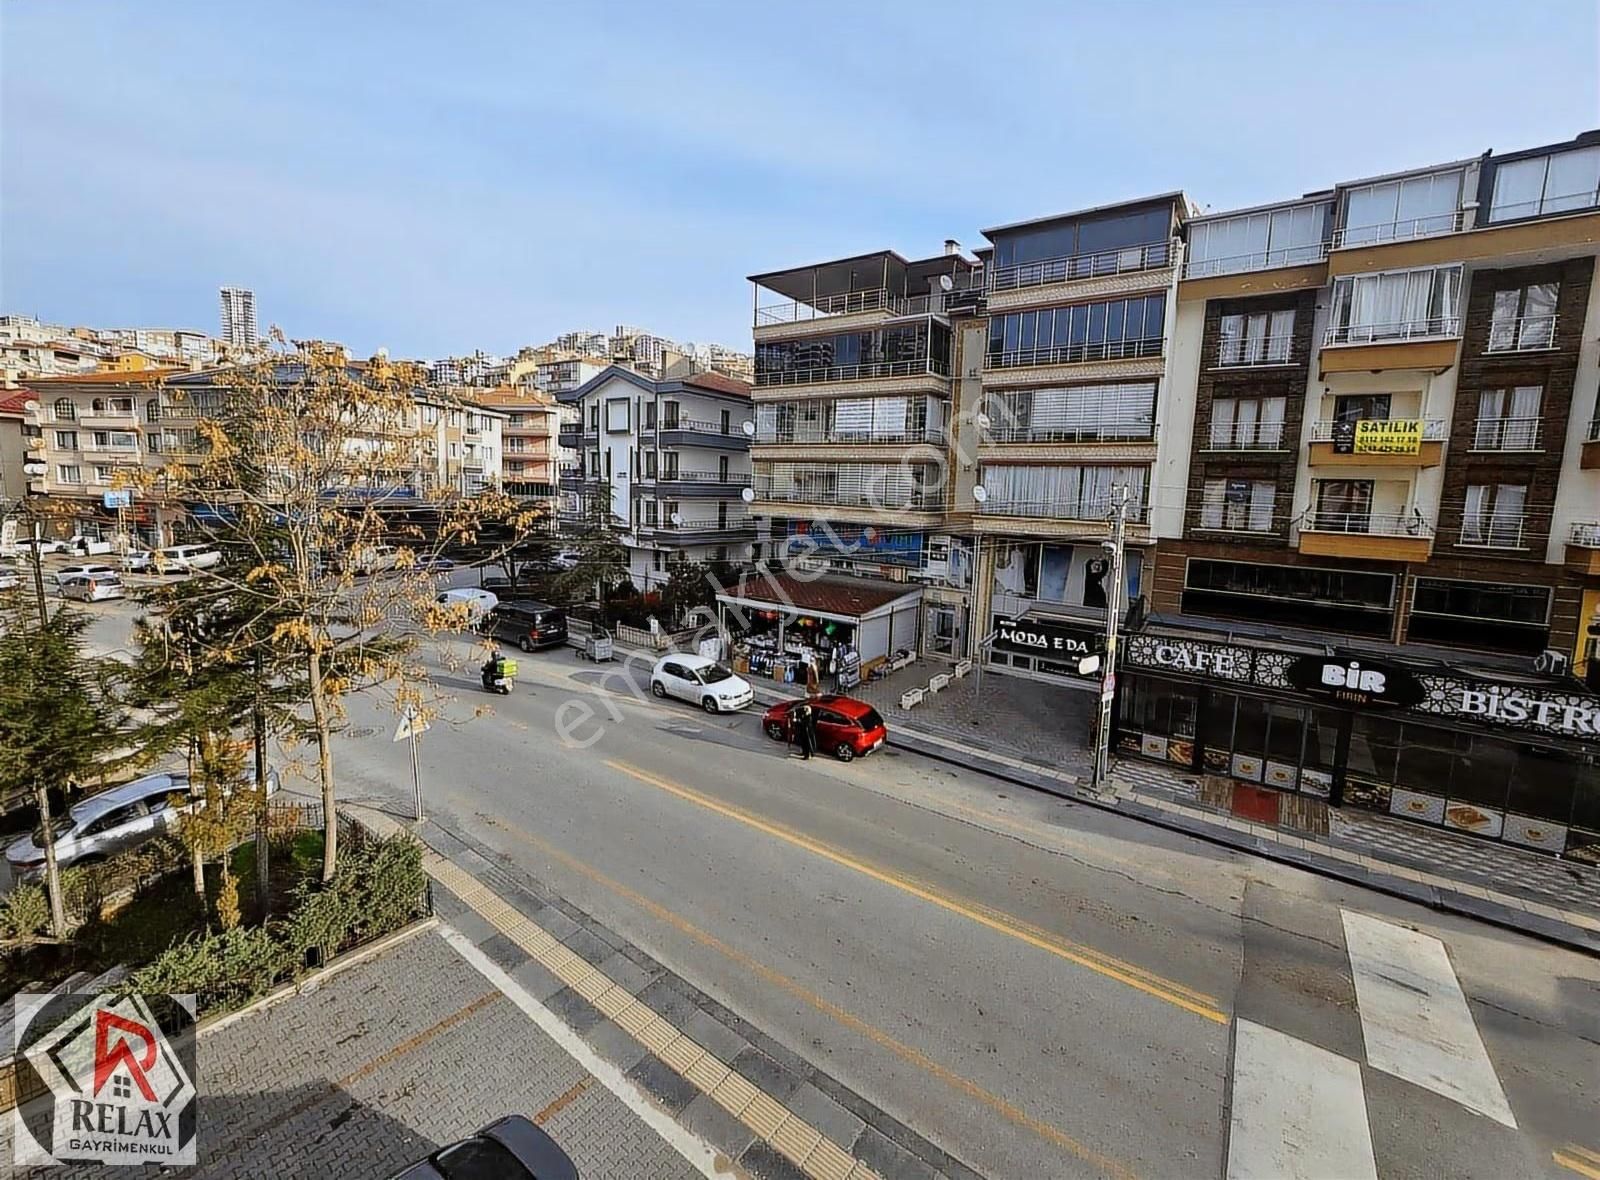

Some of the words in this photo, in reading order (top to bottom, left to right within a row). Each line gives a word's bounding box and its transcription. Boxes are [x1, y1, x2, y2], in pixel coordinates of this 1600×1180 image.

[1360, 421, 1419, 433] SATILIK
[1000, 628, 1048, 648] MODA
[1053, 637, 1089, 653] EDA
[1155, 645, 1235, 678] CAFE
[1458, 686, 1600, 734] BİSTR
